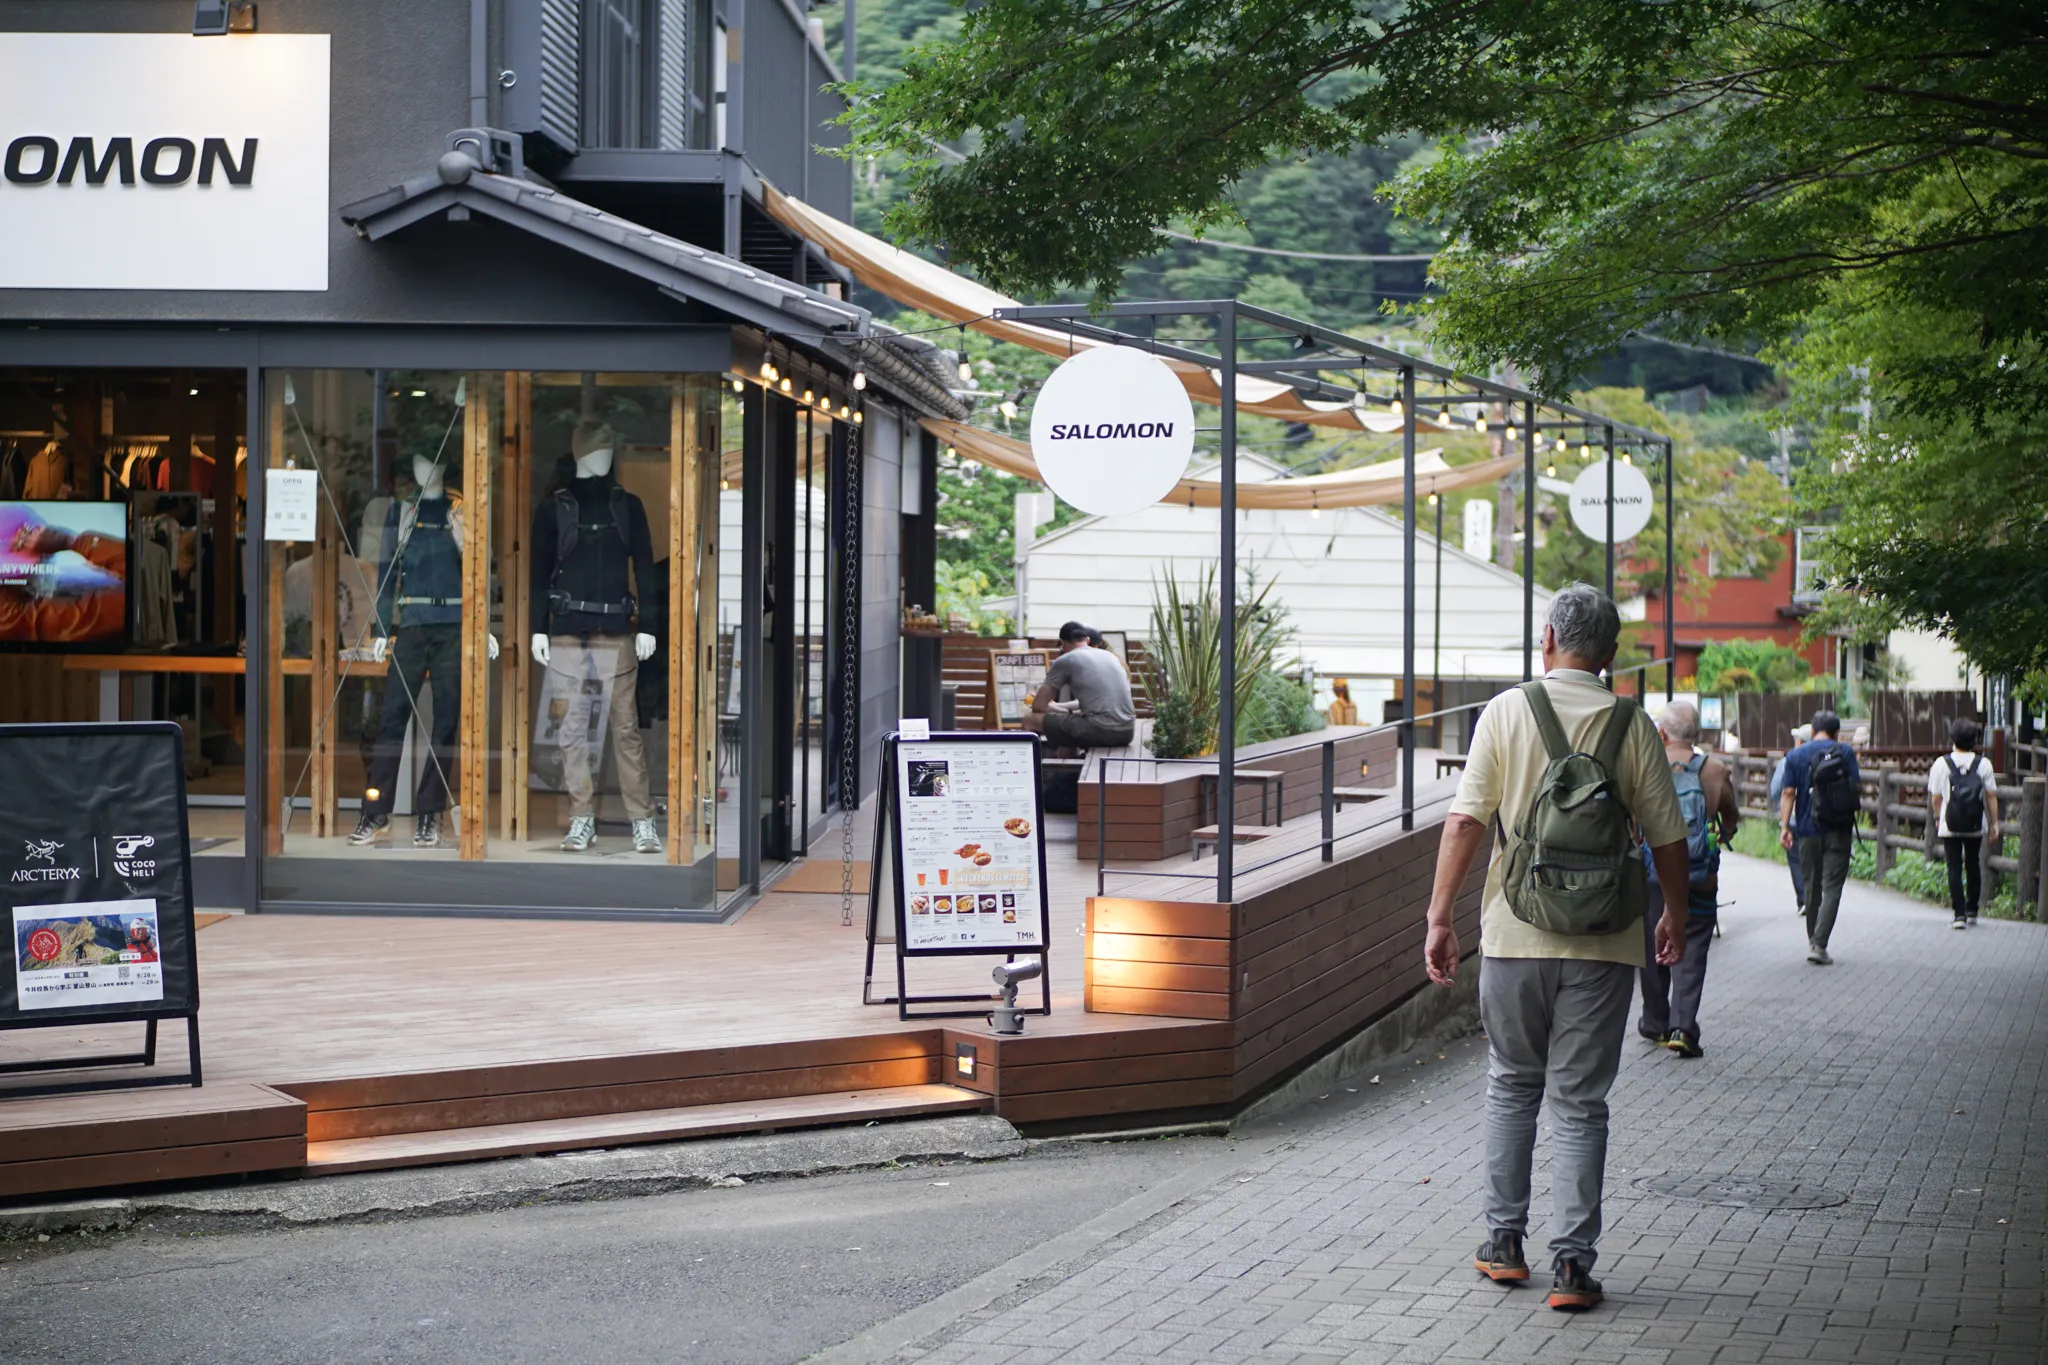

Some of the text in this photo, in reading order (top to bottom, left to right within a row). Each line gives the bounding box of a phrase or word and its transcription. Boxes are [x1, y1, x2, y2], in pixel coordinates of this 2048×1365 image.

[0, 136, 259, 185] OMON
[1050, 422, 1174, 440] SALOMON
[0, 563, 59, 574] NYWHERE
[996, 655, 1044, 665] CRAFT BEER
[131, 860, 156, 868] COCO
[11, 867, 80, 882] ARC'TERYX
[132, 869, 155, 877] HELI
